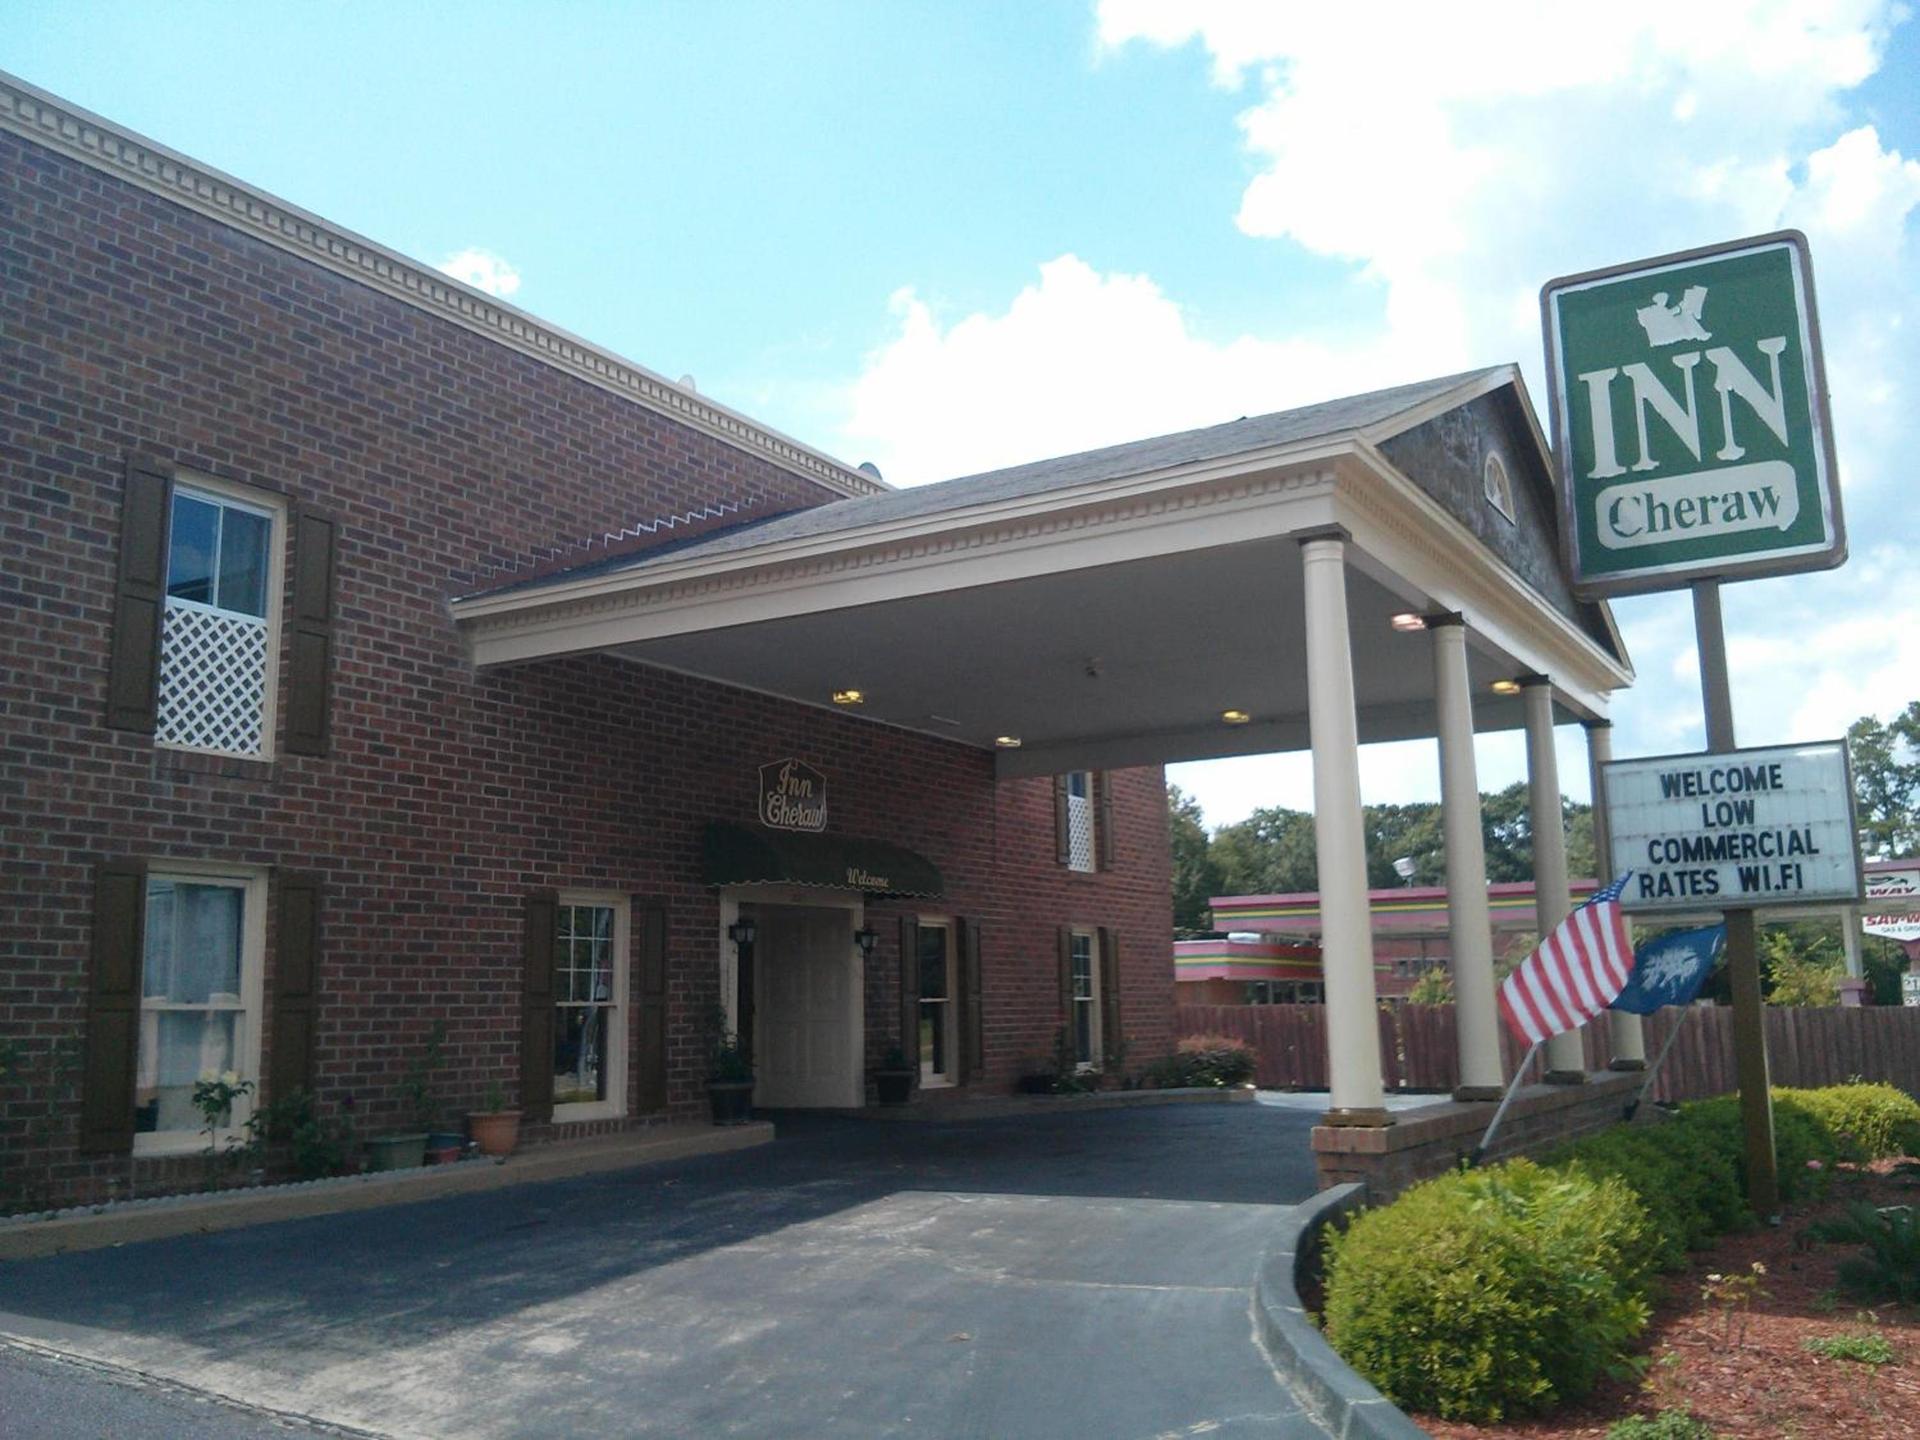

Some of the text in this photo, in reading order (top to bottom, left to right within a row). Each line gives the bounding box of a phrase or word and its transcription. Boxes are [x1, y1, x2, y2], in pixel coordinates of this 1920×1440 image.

[1578, 336, 1789, 479] INN
[1609, 486, 1781, 538] Cheraw
[777, 762, 813, 798] Inn
[1660, 764, 1784, 799] WELCOME
[1702, 799, 1755, 828] LOW
[1648, 829, 1820, 865] COMMERCIAL
[846, 867, 889, 888] Welcome
[1638, 869, 1719, 899] RATES
